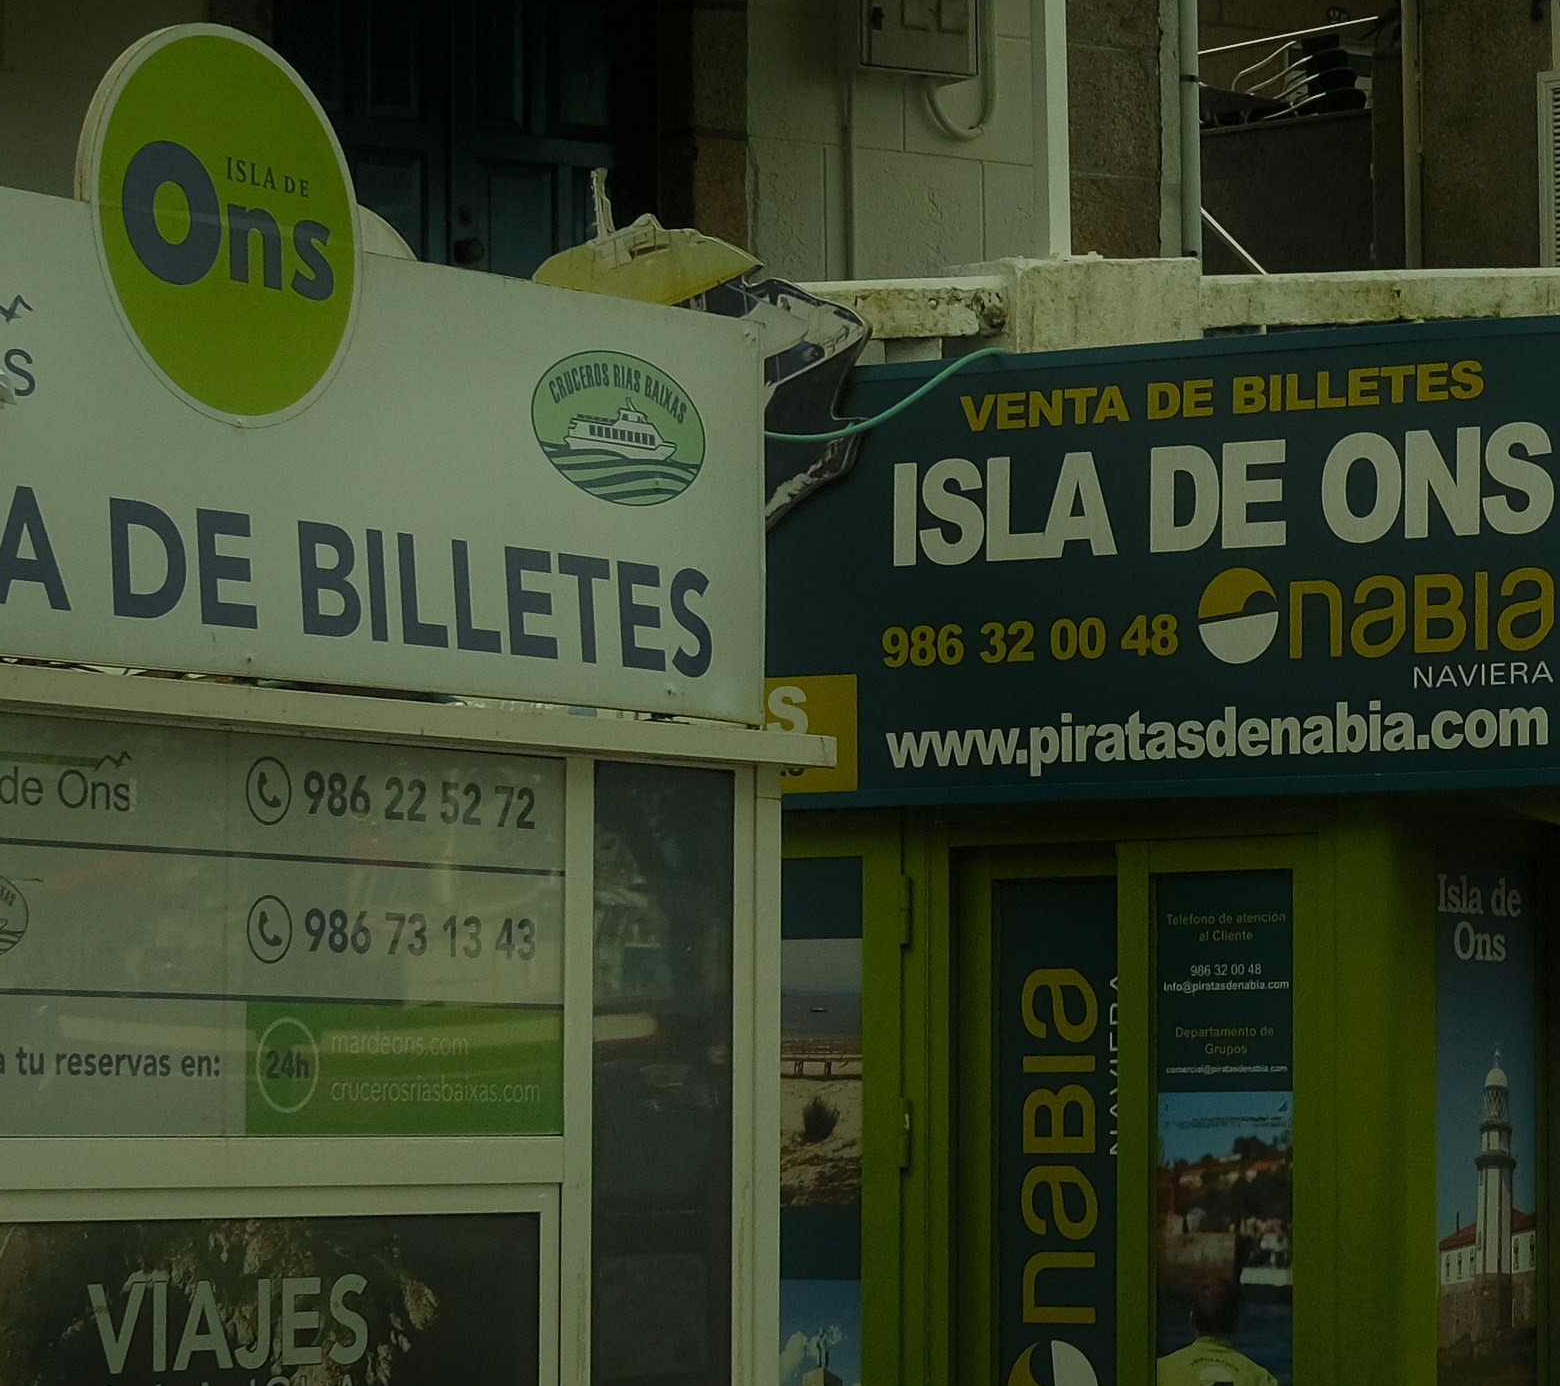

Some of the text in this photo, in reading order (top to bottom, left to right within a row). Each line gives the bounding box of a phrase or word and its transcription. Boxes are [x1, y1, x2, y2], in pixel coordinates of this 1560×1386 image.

[122, 139, 335, 303] Ons
[548, 362, 688, 425] CRUCEROS RIAS BAIXAS
[960, 359, 1486, 434] VENTA DE BILLETES
[892, 420, 1556, 568] ISLA DE ONS
[109, 497, 258, 630] DE
[299, 519, 714, 679] BILLETES
[880, 611, 1180, 670] 986 32 00 48
[1412, 660, 1555, 690] NAVIERA
[883, 699, 1551, 779] www.piratasdenabia.com
[303, 770, 536, 830] 986 22 52 72
[1436, 873, 1523, 918] Isla de
[1453, 920, 1508, 963] Ons
[14, 1044, 46, 1078] tu
[55, 1046, 173, 1080] reservas
[180, 1049, 222, 1081] en:
[265, 1049, 311, 1080] 24h
[330, 1027, 470, 1057] mardeons.com
[330, 1075, 541, 1105] crucerosriasbaixas.com
[86, 1272, 369, 1375] VIAJES
